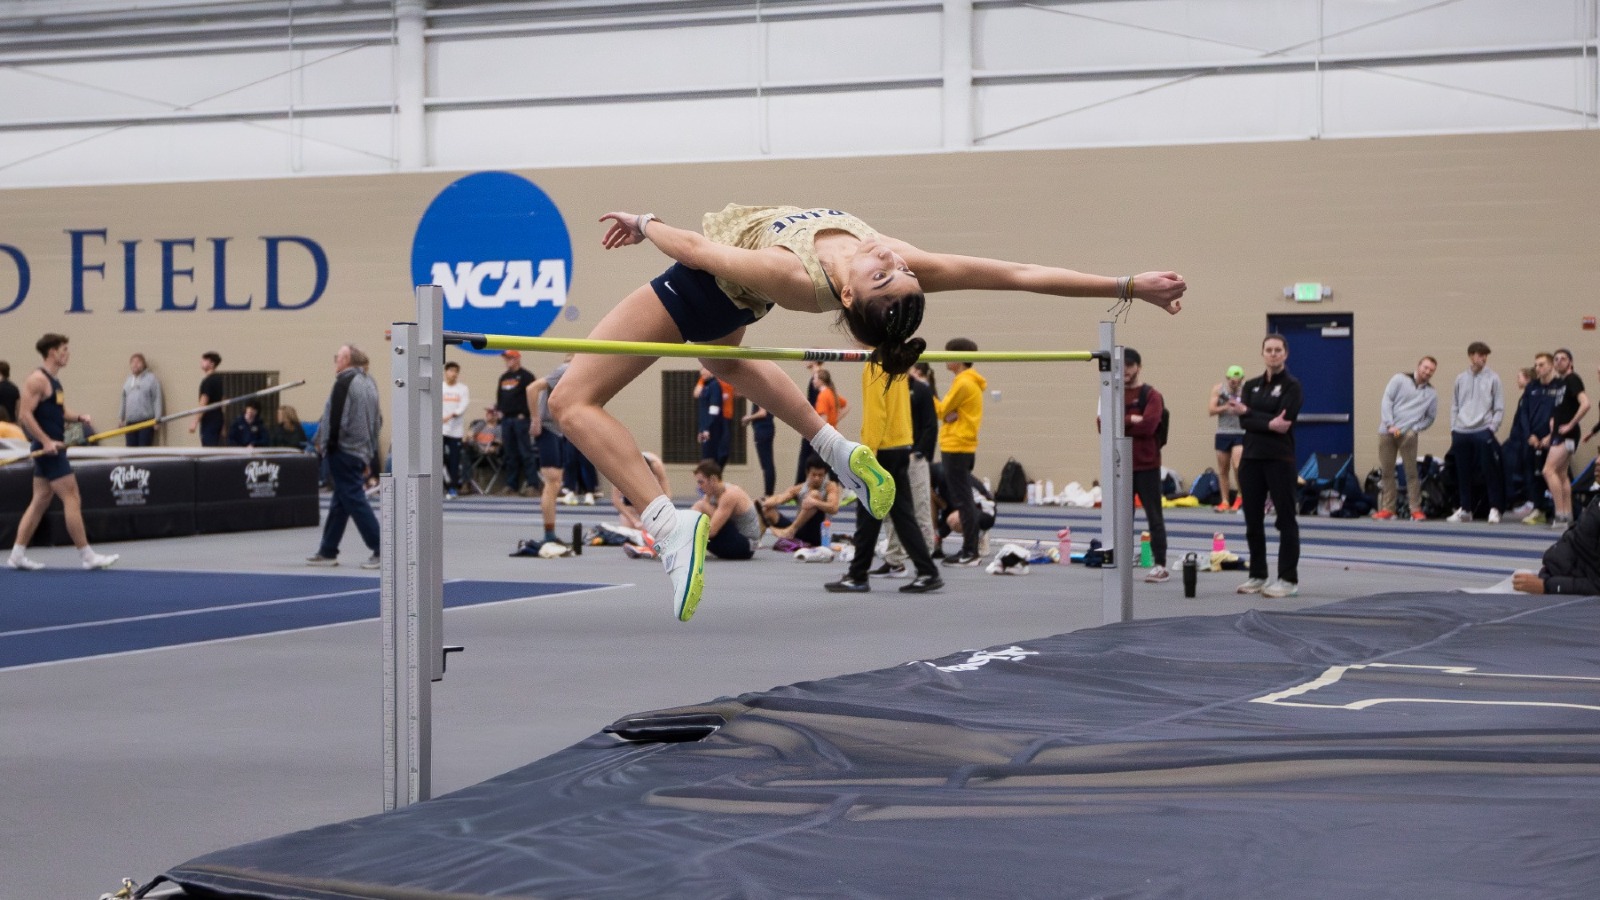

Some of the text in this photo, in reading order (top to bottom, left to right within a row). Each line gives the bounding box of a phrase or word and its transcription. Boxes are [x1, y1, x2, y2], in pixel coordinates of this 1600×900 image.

[63, 228, 329, 314] FIELD
[430, 259, 567, 309] NCAA
[110, 465, 150, 490] Richey
